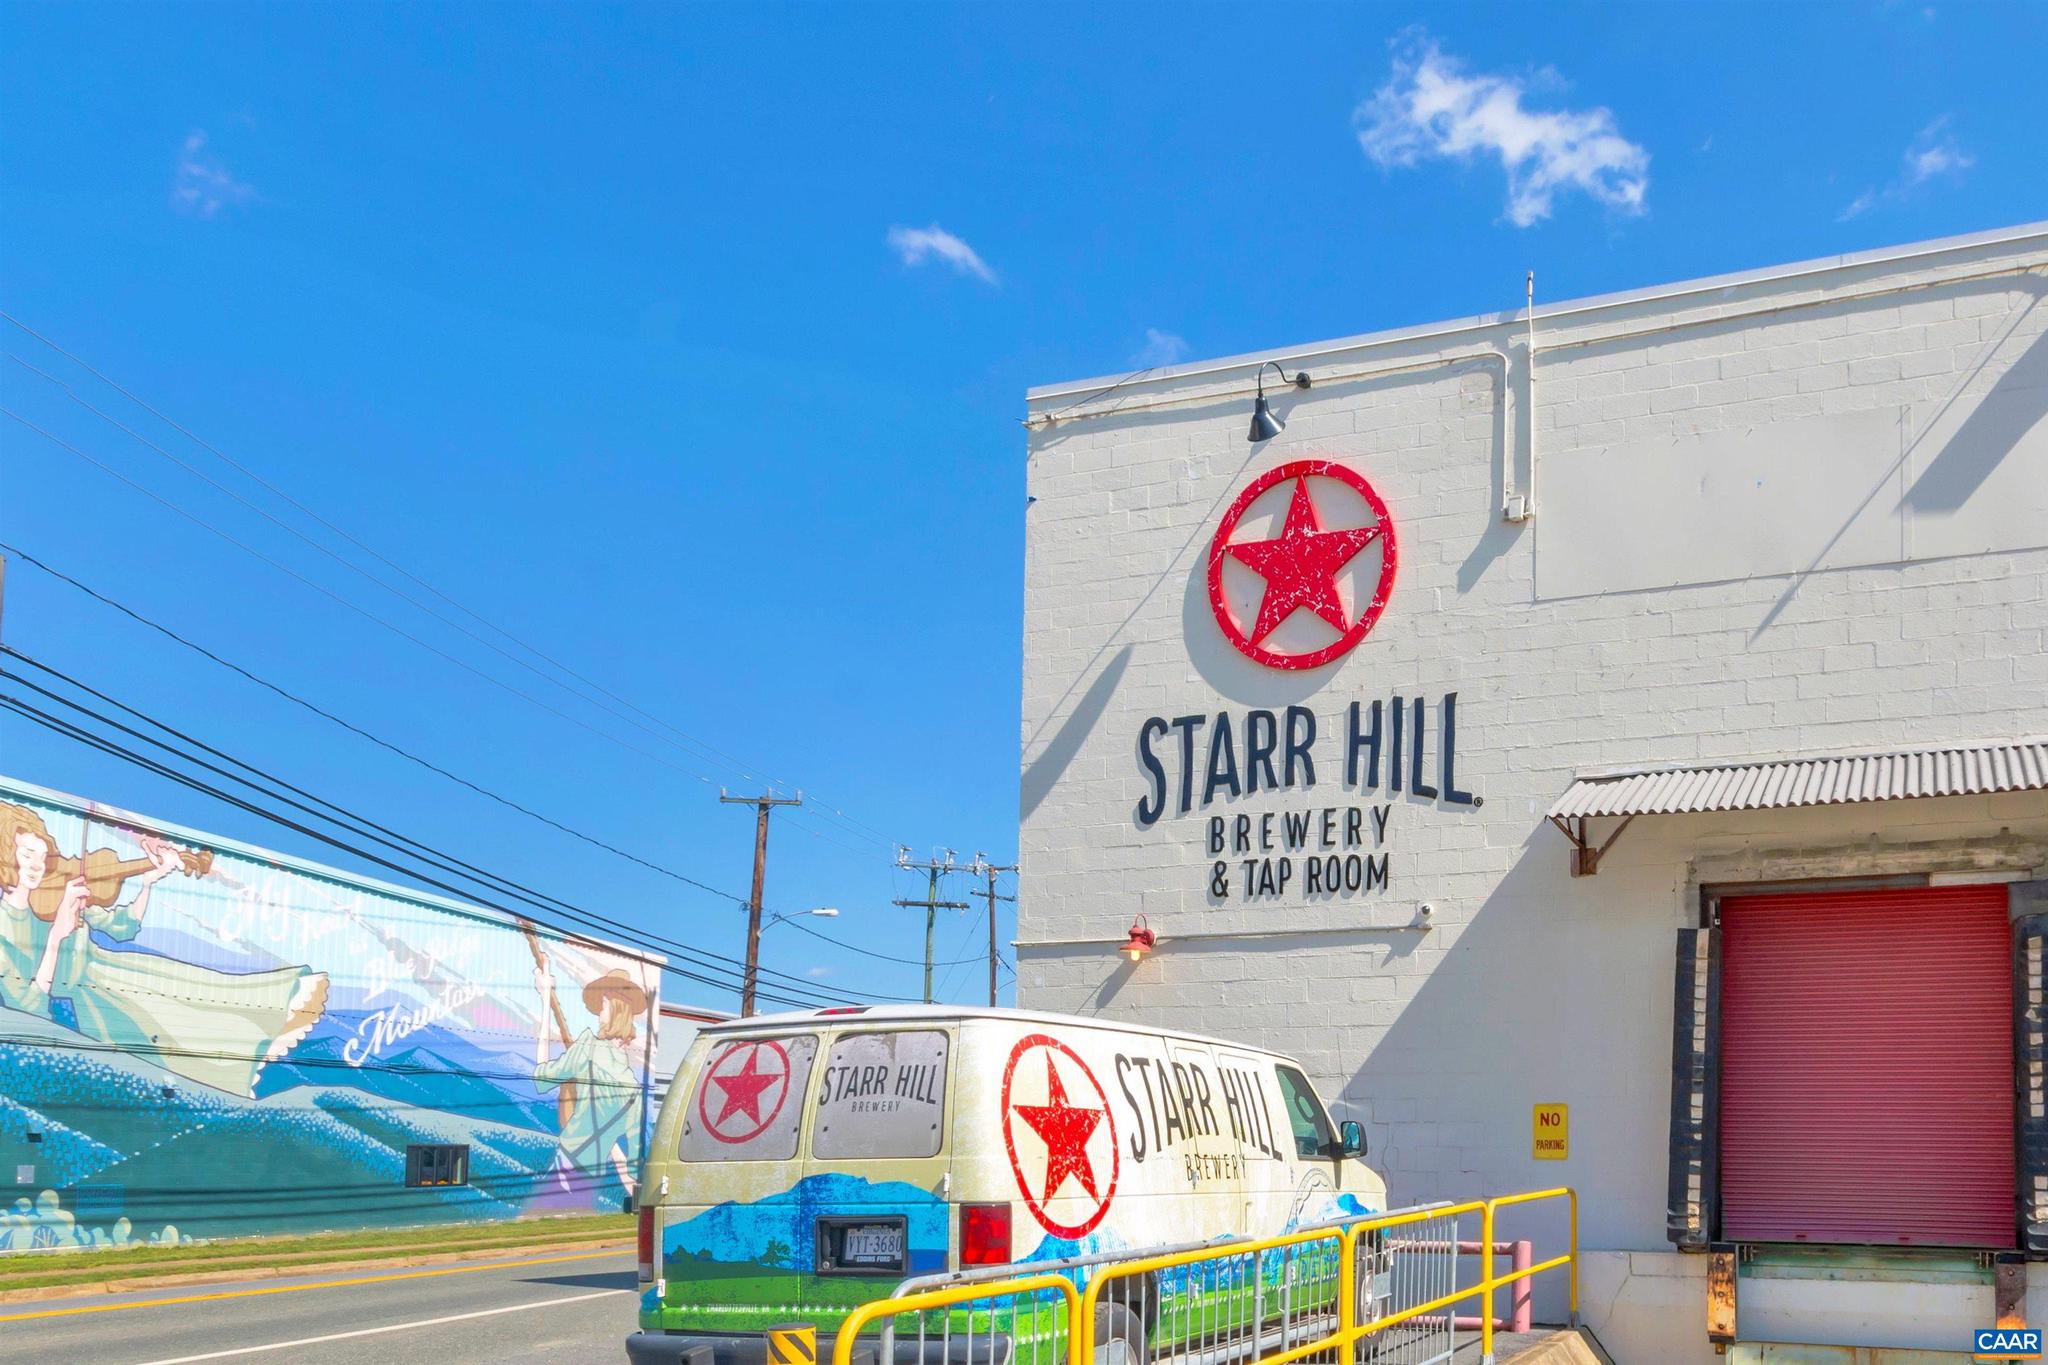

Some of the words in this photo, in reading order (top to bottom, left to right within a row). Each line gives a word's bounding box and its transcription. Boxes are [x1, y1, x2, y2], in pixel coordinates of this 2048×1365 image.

[1138, 705, 1317, 825] STARR
[1347, 692, 1473, 805] HILL
[1211, 804, 1391, 853] BREWERY
[1211, 860, 1229, 898] &
[1243, 857, 1292, 896] TAP
[1308, 852, 1389, 894] ROOM
[819, 1065, 889, 1106] STARR
[895, 1064, 937, 1105] HILL
[851, 1101, 901, 1113] BREWERY
[1115, 1053, 1220, 1163] STARR
[1217, 1066, 1283, 1162] HILL
[1540, 1112, 1560, 1126] NO
[1536, 1139, 1565, 1151] PARKING
[1185, 1153, 1247, 1181] BREWERY
[848, 1235, 903, 1254] VYT-3680
